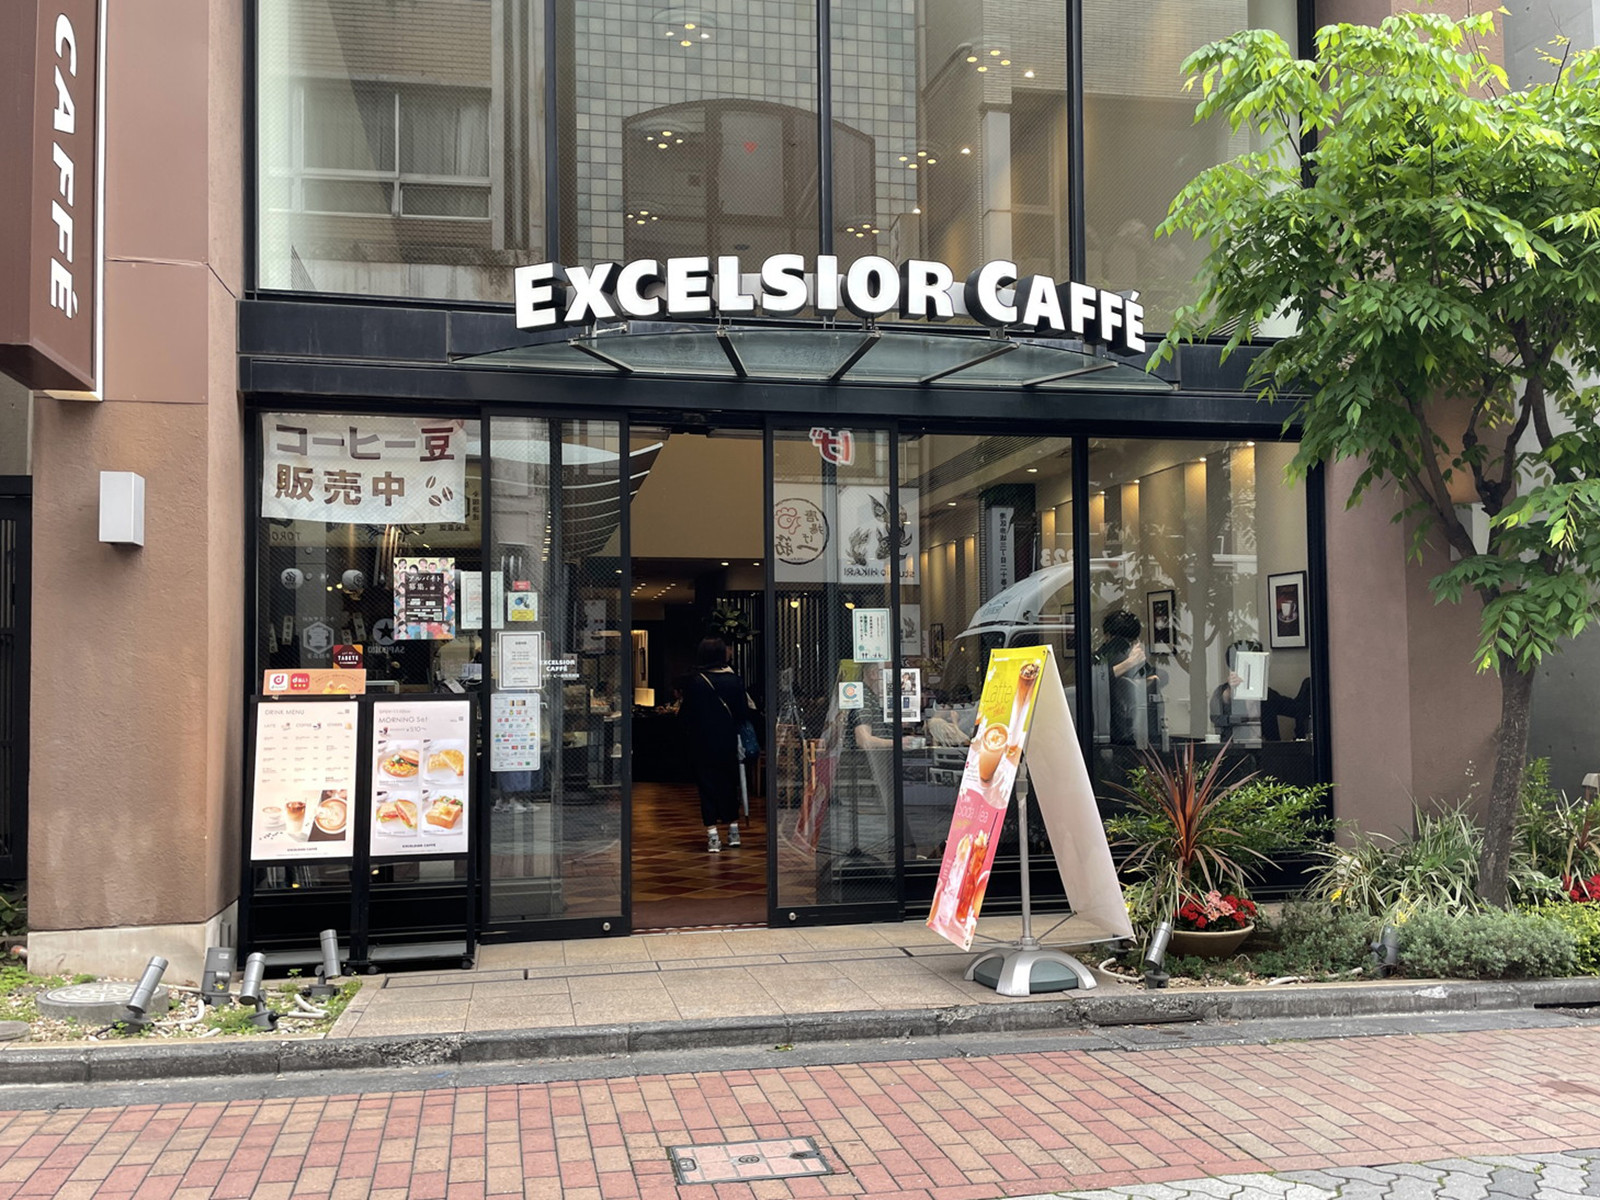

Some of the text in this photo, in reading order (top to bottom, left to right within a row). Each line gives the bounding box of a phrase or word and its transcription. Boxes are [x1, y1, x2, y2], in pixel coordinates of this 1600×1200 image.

[50, 13, 78, 320] CAFFÉ
[514, 253, 1146, 354] EXCELSIOR CAFFÉ
[275, 423, 455, 462] コーヒー豆
[274, 463, 405, 507] 販売中
